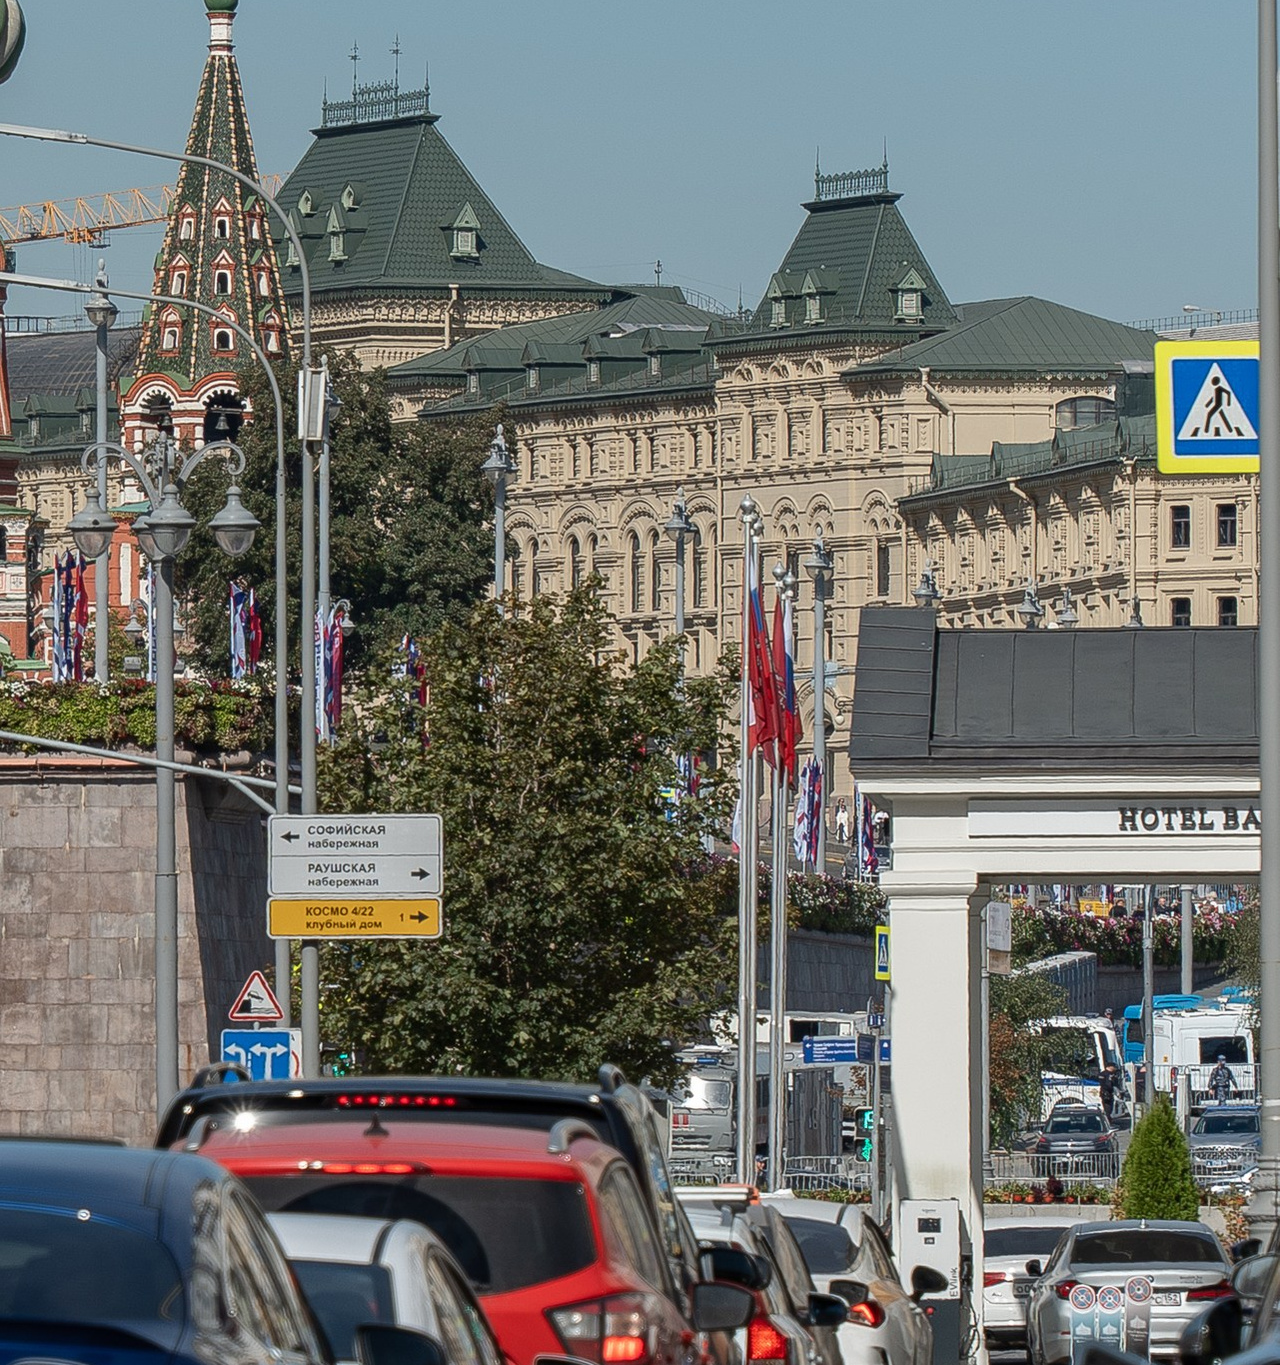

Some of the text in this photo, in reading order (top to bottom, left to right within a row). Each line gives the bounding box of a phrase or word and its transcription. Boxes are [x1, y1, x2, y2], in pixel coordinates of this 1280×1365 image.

[1118, 807, 1214, 831] HOTEL
[307, 823, 386, 836] СОФИЙСКАЯ
[307, 838, 379, 851] набережная
[308, 863, 376, 873] РАУШСКАЯ
[307, 877, 379, 889] набережная
[305, 906, 405, 922] КОСМО 4/22 1
[306, 919, 383, 931] клубный дом
